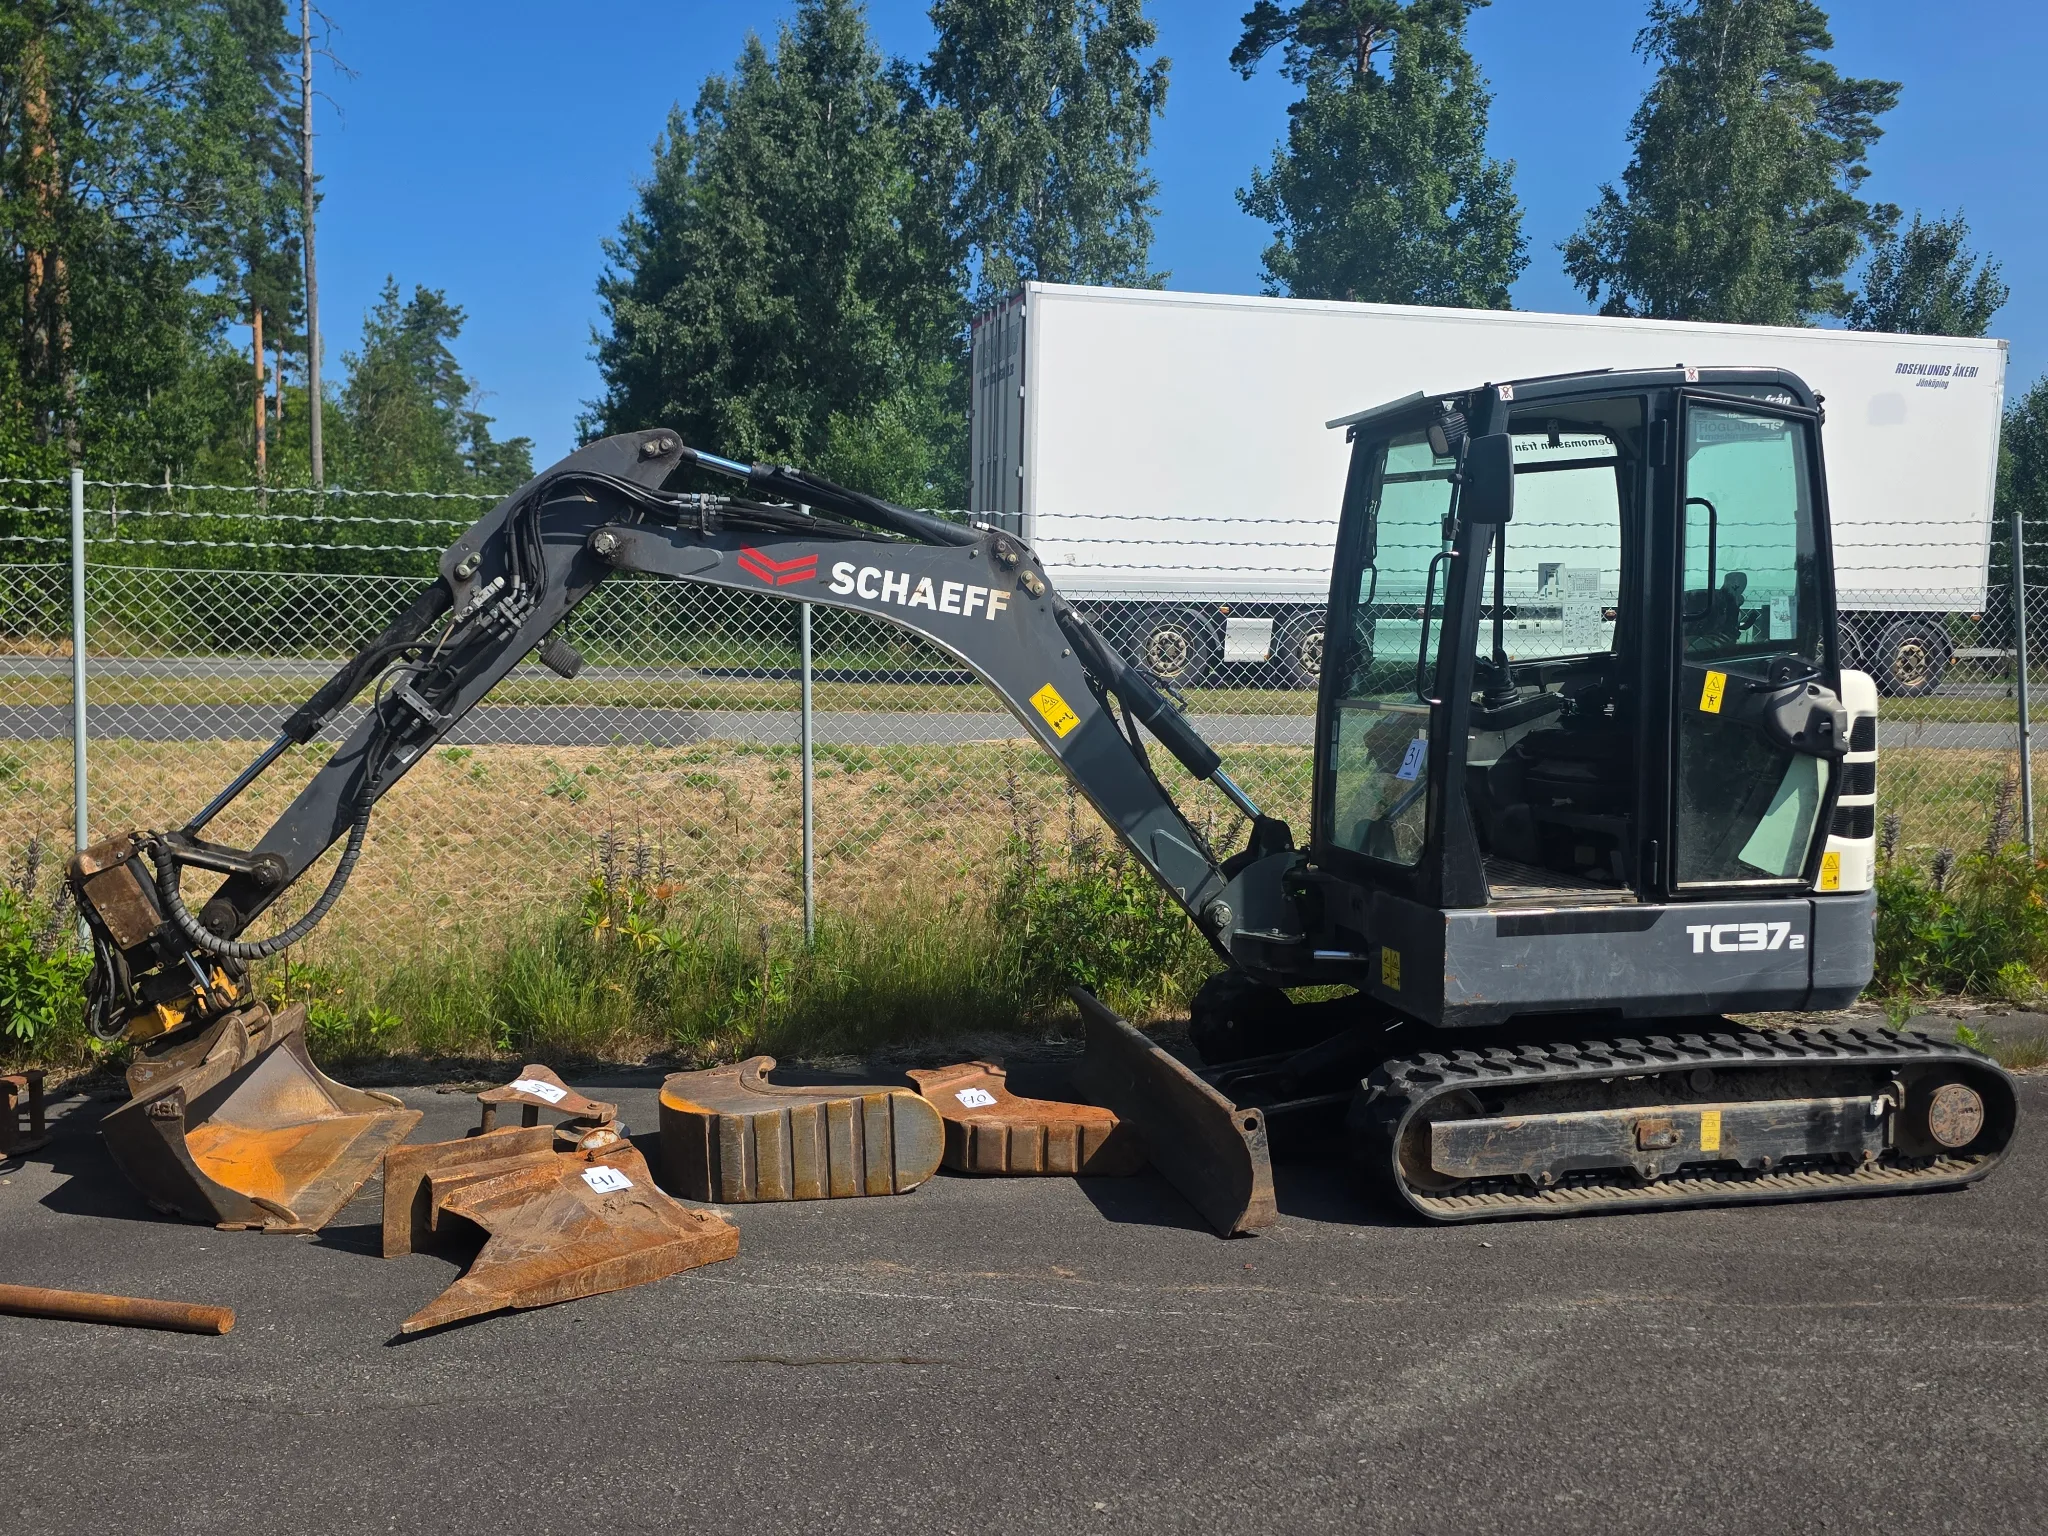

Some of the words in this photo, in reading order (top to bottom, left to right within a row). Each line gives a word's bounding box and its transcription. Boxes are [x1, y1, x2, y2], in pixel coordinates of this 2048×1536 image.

[1895, 363, 1952, 377] ROSENLUNDS
[1952, 363, 1979, 378] ÅKERI
[1916, 379, 1949, 389] Jönköping
[829, 562, 1011, 621] SCHAEFF
[1405, 747, 1420, 768] 31
[963, 1095, 987, 1104] 40
[591, 1175, 614, 1186] 41
